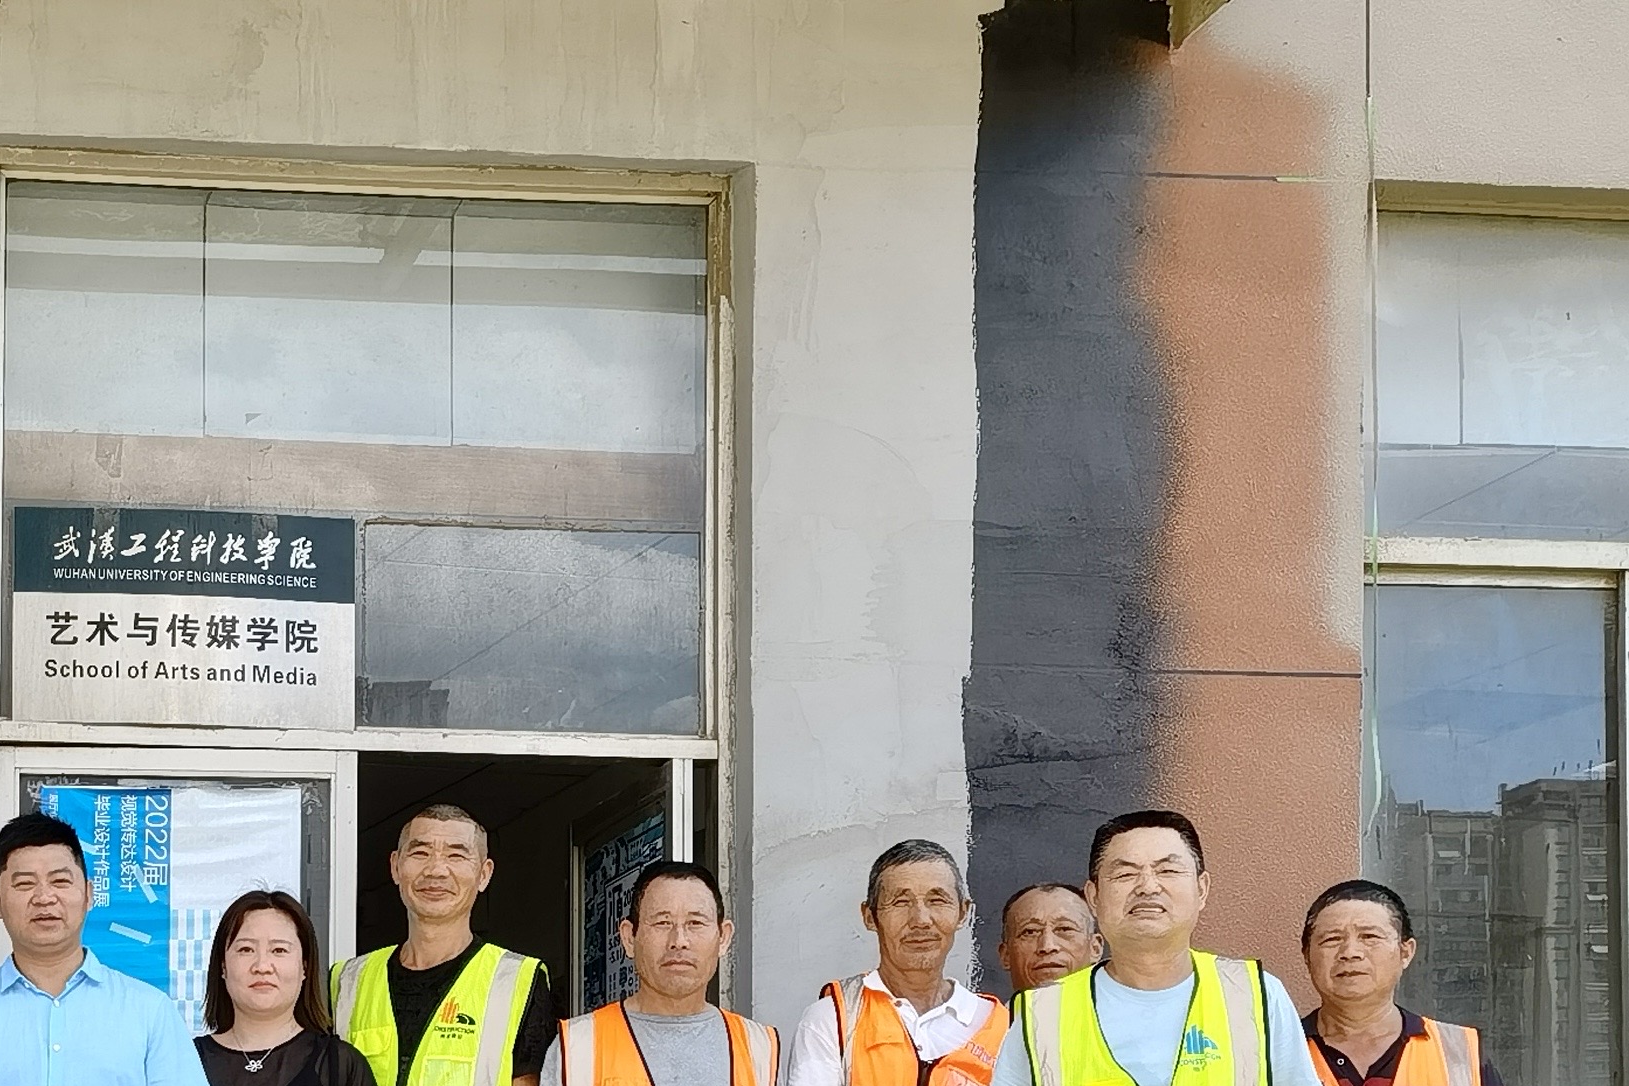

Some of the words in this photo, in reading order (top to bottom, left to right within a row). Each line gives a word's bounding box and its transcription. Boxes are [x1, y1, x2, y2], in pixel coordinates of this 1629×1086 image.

[53, 568, 96, 579] WUHAN
[98, 569, 168, 581] UNIVERSITY
[169, 570, 185, 581] OF
[186, 571, 266, 585] ENGINEERING
[266, 575, 317, 588] SCIENCE
[45, 611, 319, 653] 艺术与传媒学院
[44, 659, 119, 679] School
[127, 660, 148, 679] of
[154, 662, 200, 681] Arts
[206, 664, 245, 683] and
[252, 665, 318, 686] Media
[93, 794, 111, 908] 毕业设计作品展
[120, 794, 137, 893] 视觉传达设计
[143, 795, 169, 886] 2022届
